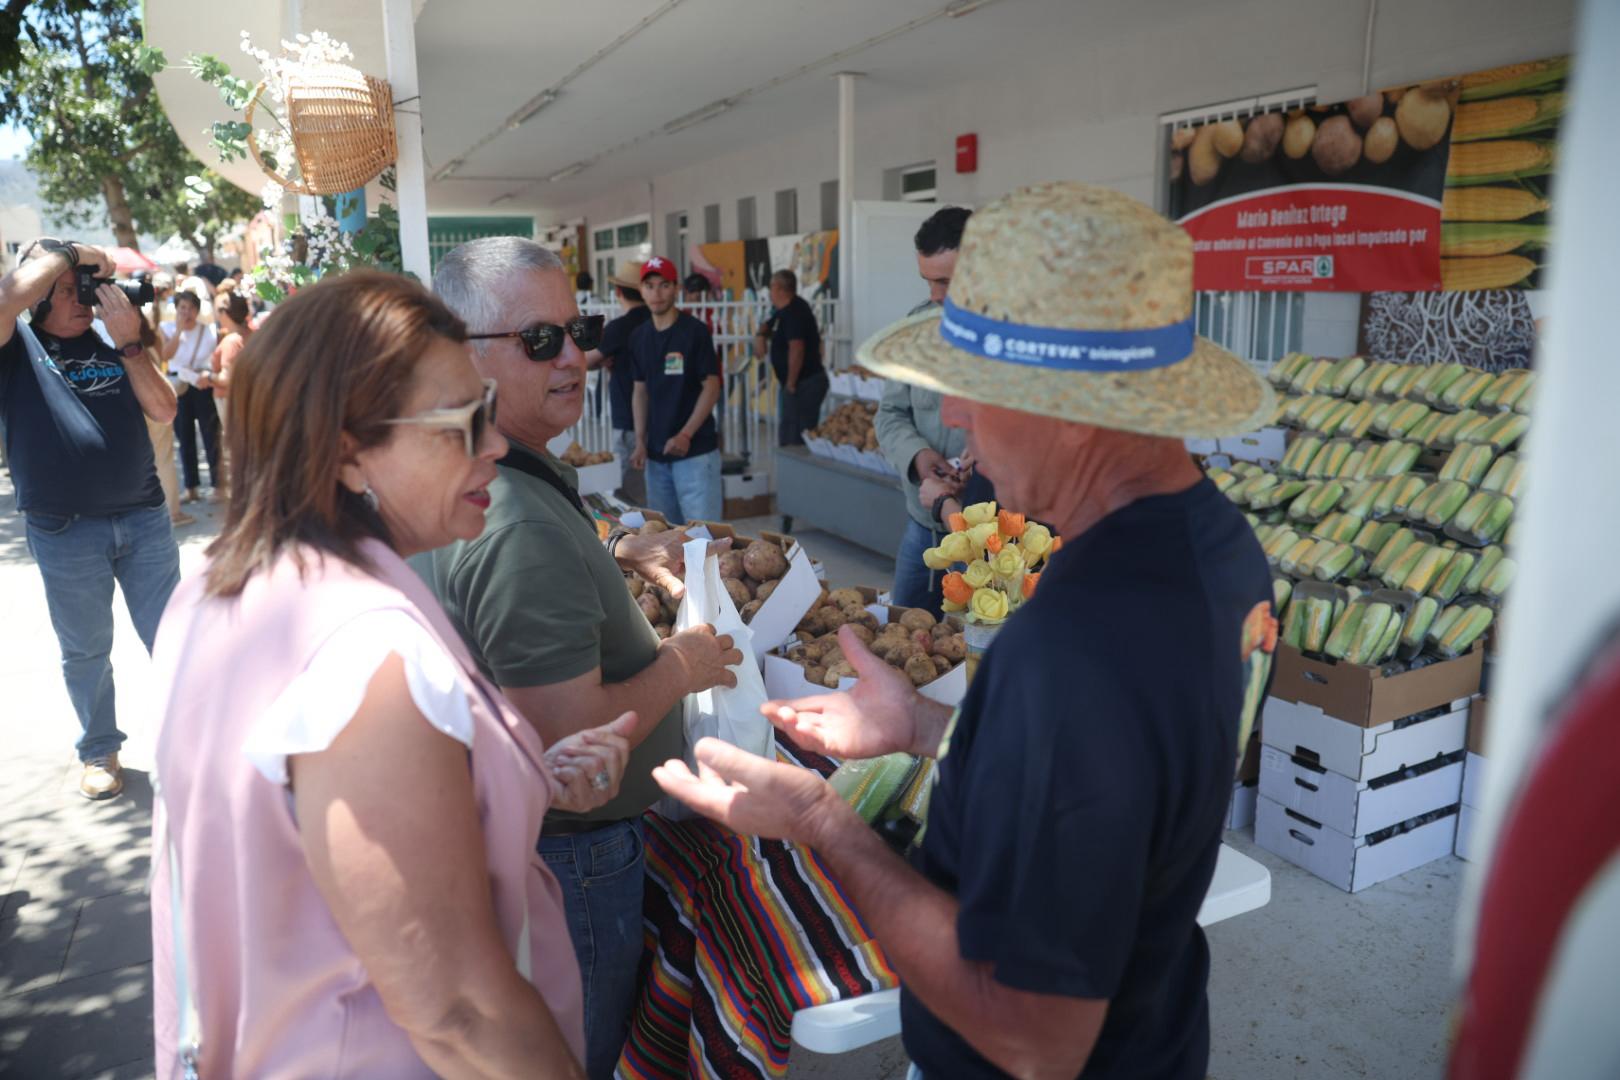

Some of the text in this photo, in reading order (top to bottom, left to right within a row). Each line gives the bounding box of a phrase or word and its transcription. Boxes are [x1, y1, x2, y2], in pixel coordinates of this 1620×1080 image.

[1236, 209, 1268, 228] Mario
[1310, 204, 1347, 228] Ortega
[1333, 231, 1355, 246] local
[1356, 229, 1406, 248] impulsado
[1408, 229, 1426, 247] por
[1262, 260, 1312, 275] SPAR
